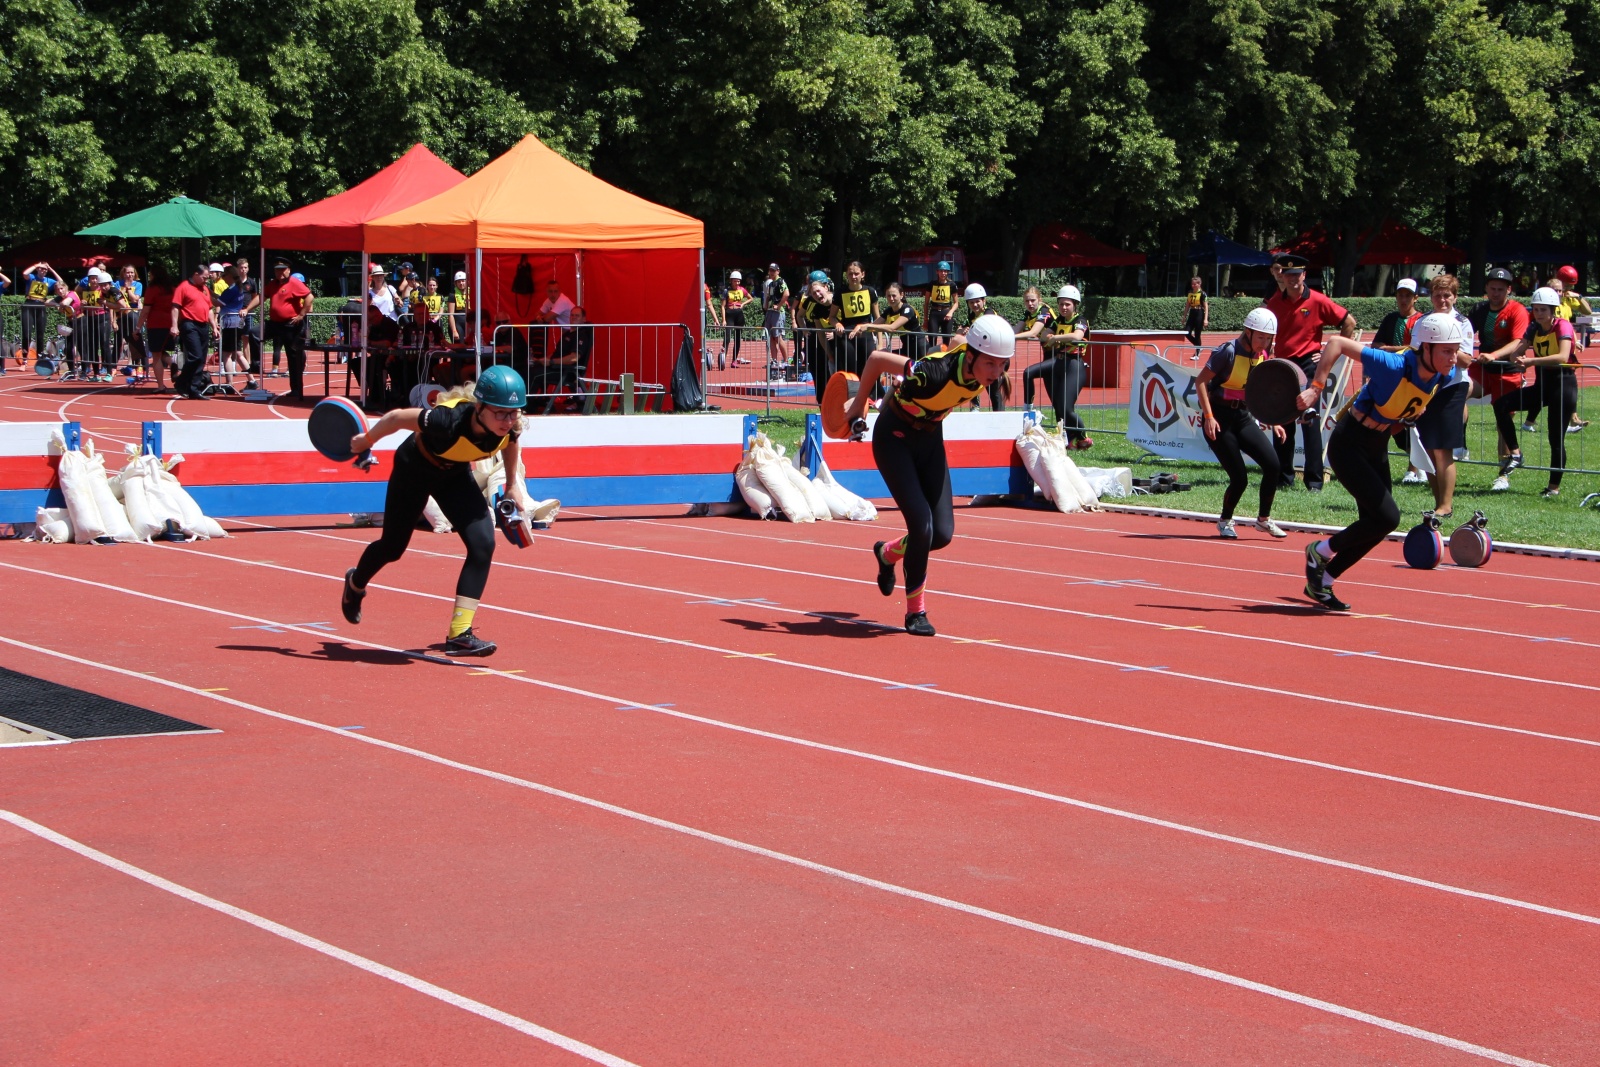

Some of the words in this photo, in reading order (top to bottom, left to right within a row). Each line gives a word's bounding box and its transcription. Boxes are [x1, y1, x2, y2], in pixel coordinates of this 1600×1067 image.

[936, 288, 946, 301] 20
[849, 295, 865, 314] 56
[1536, 340, 1550, 357] 17
[1396, 396, 1423, 419] 6
[1133, 437, 1185, 449] www.probo-nb.cz
